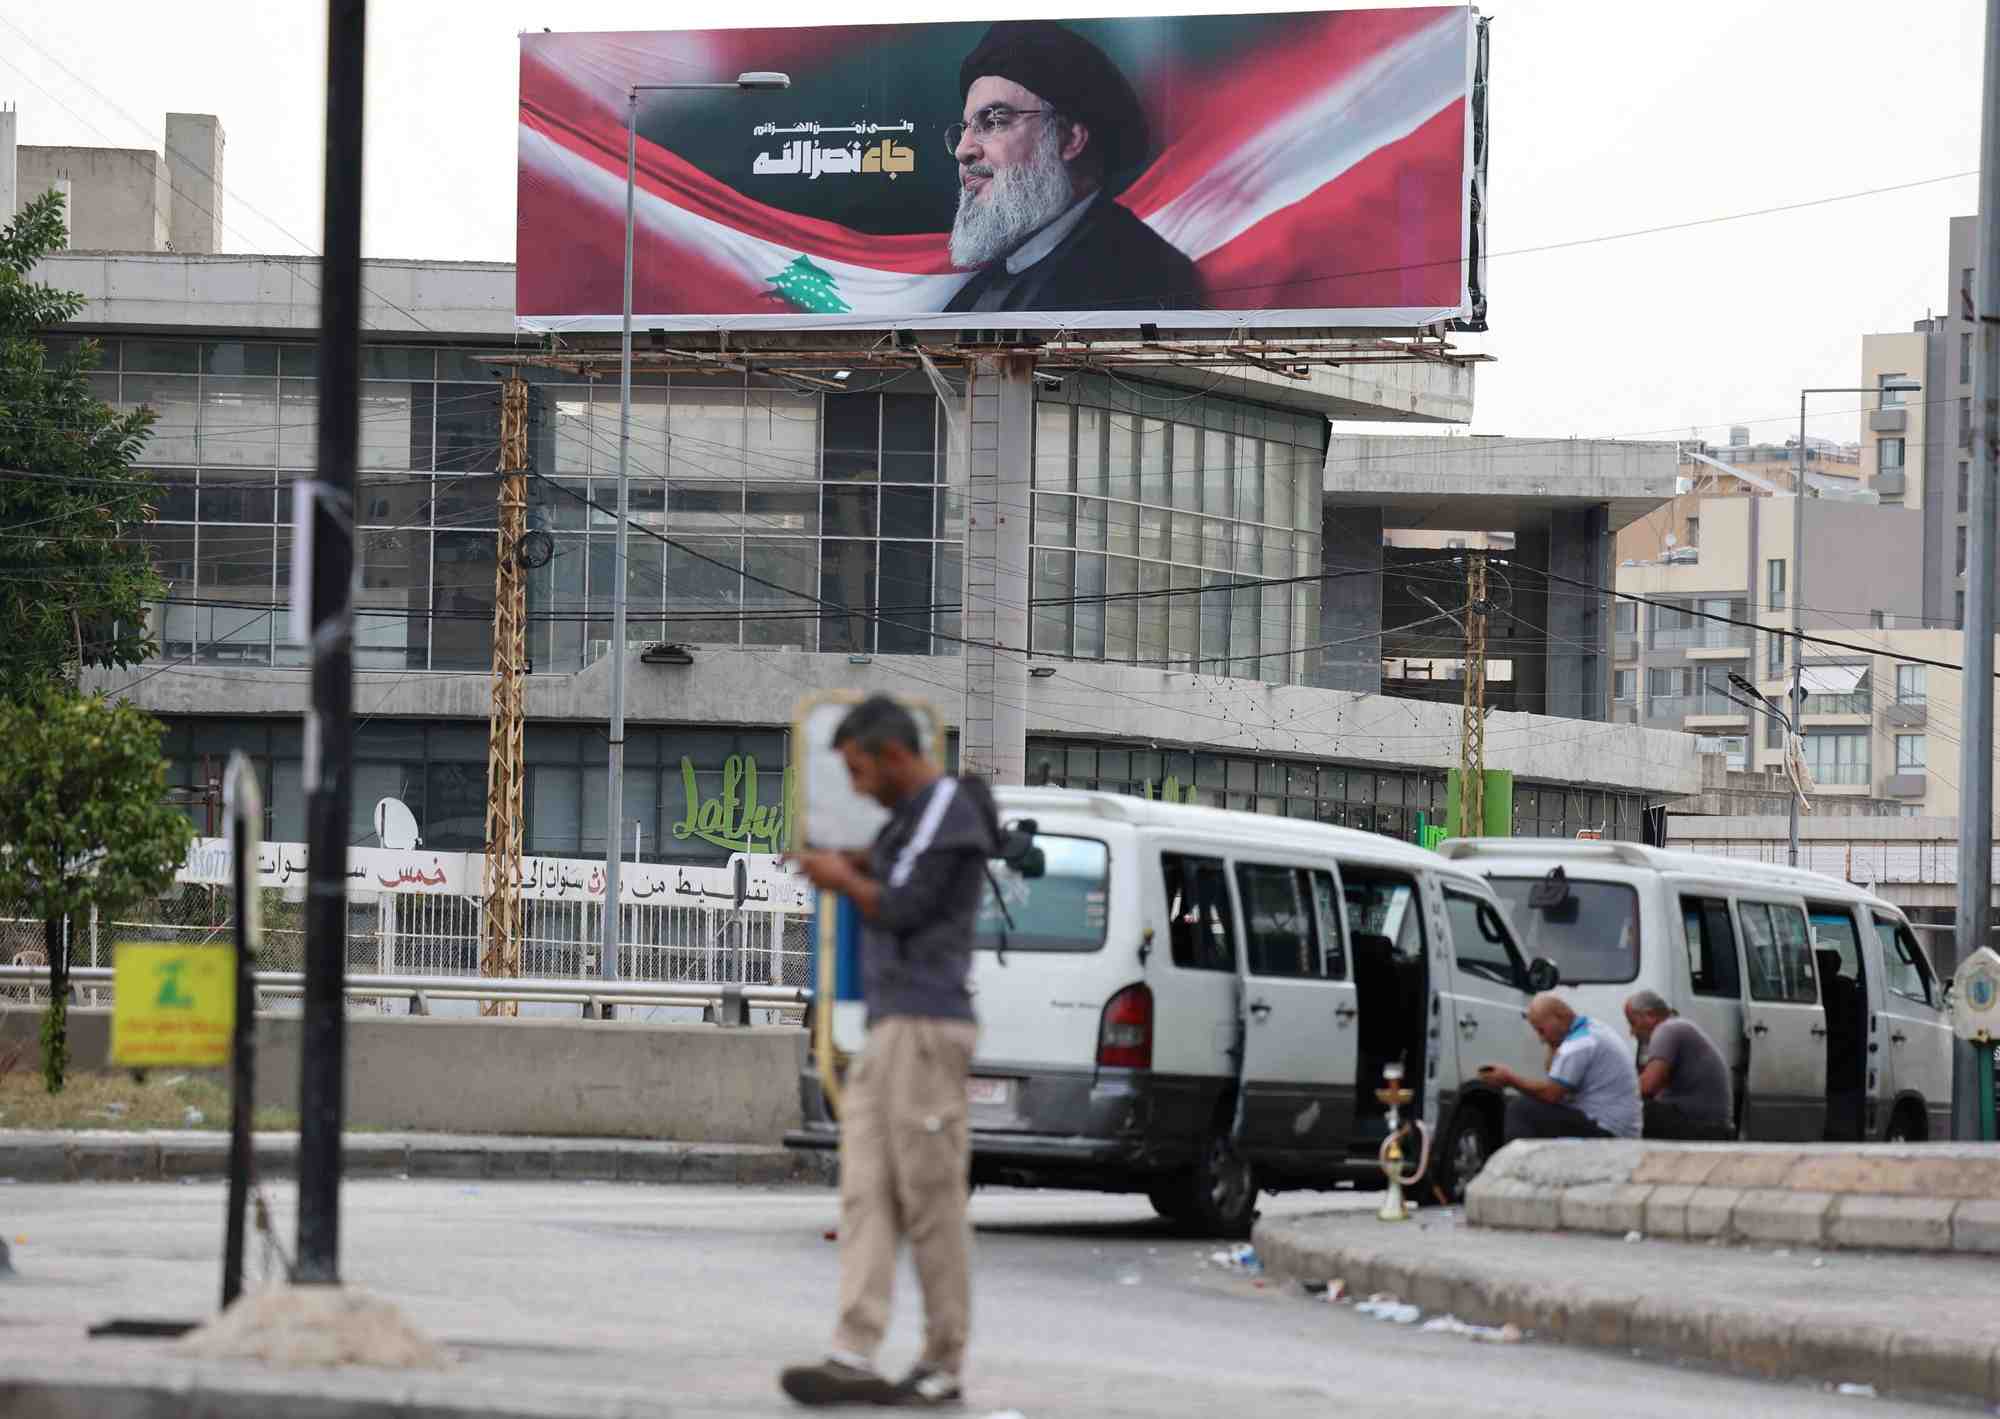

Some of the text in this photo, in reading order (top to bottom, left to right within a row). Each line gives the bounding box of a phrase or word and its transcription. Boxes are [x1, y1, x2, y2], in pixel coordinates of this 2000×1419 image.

[377, 857, 447, 887] خمس
[545, 862, 584, 896] سنوات
[631, 875, 665, 898] من
